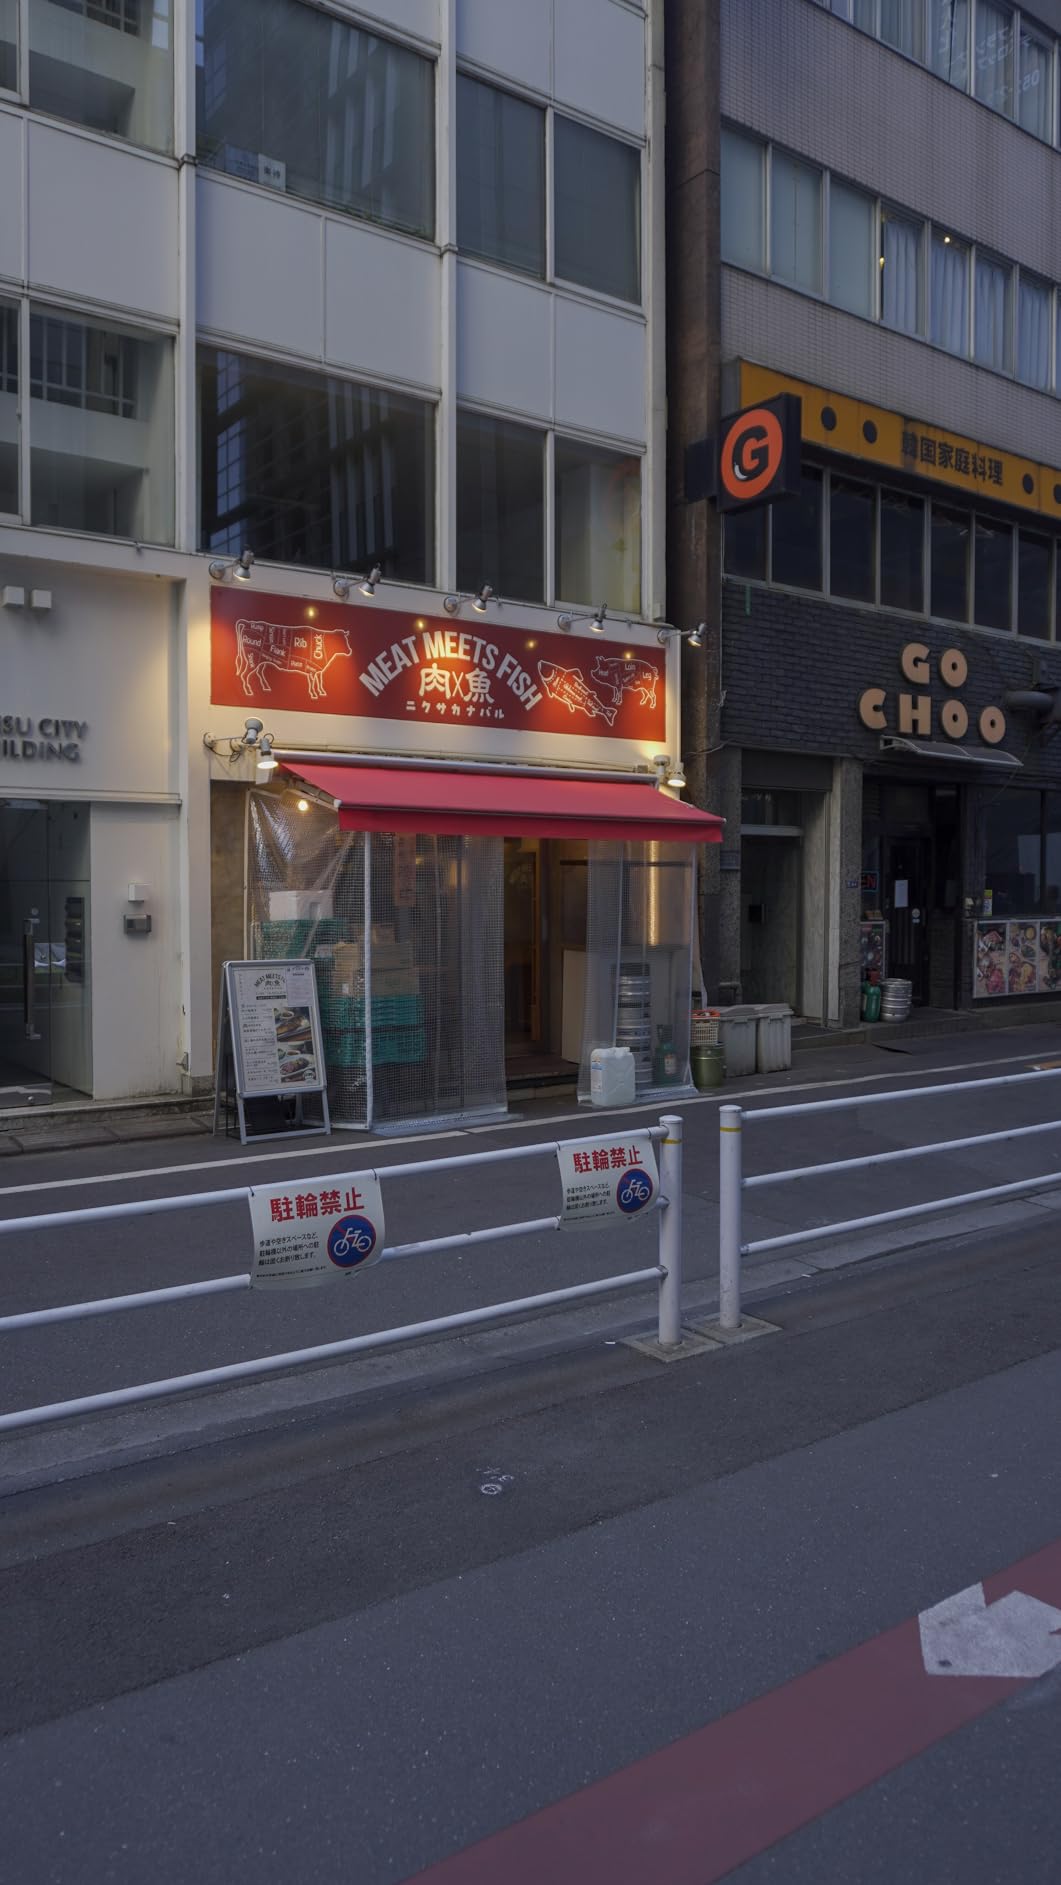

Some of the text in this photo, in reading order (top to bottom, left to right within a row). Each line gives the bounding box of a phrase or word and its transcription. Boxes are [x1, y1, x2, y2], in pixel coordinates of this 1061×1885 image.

[732, 425, 770, 481] G
[901, 430, 1004, 486] 韓国家庭料理
[243, 635, 262, 647] Round
[270, 645, 287, 657] Flank
[294, 637, 308, 648] Rib
[314, 634, 323, 659] Chuck
[359, 631, 544, 712] MEAT MEETS FISH
[901, 642, 968, 689] GO
[405, 700, 505, 720] ニクサカナバル
[859, 687, 1007, 745] CHOO
[0, 715, 89, 740] SU CITY
[0, 738, 81, 761] ILDING
[573, 1145, 643, 1174] 駐輪禁止
[269, 1186, 365, 1223] 駐輪禁止
